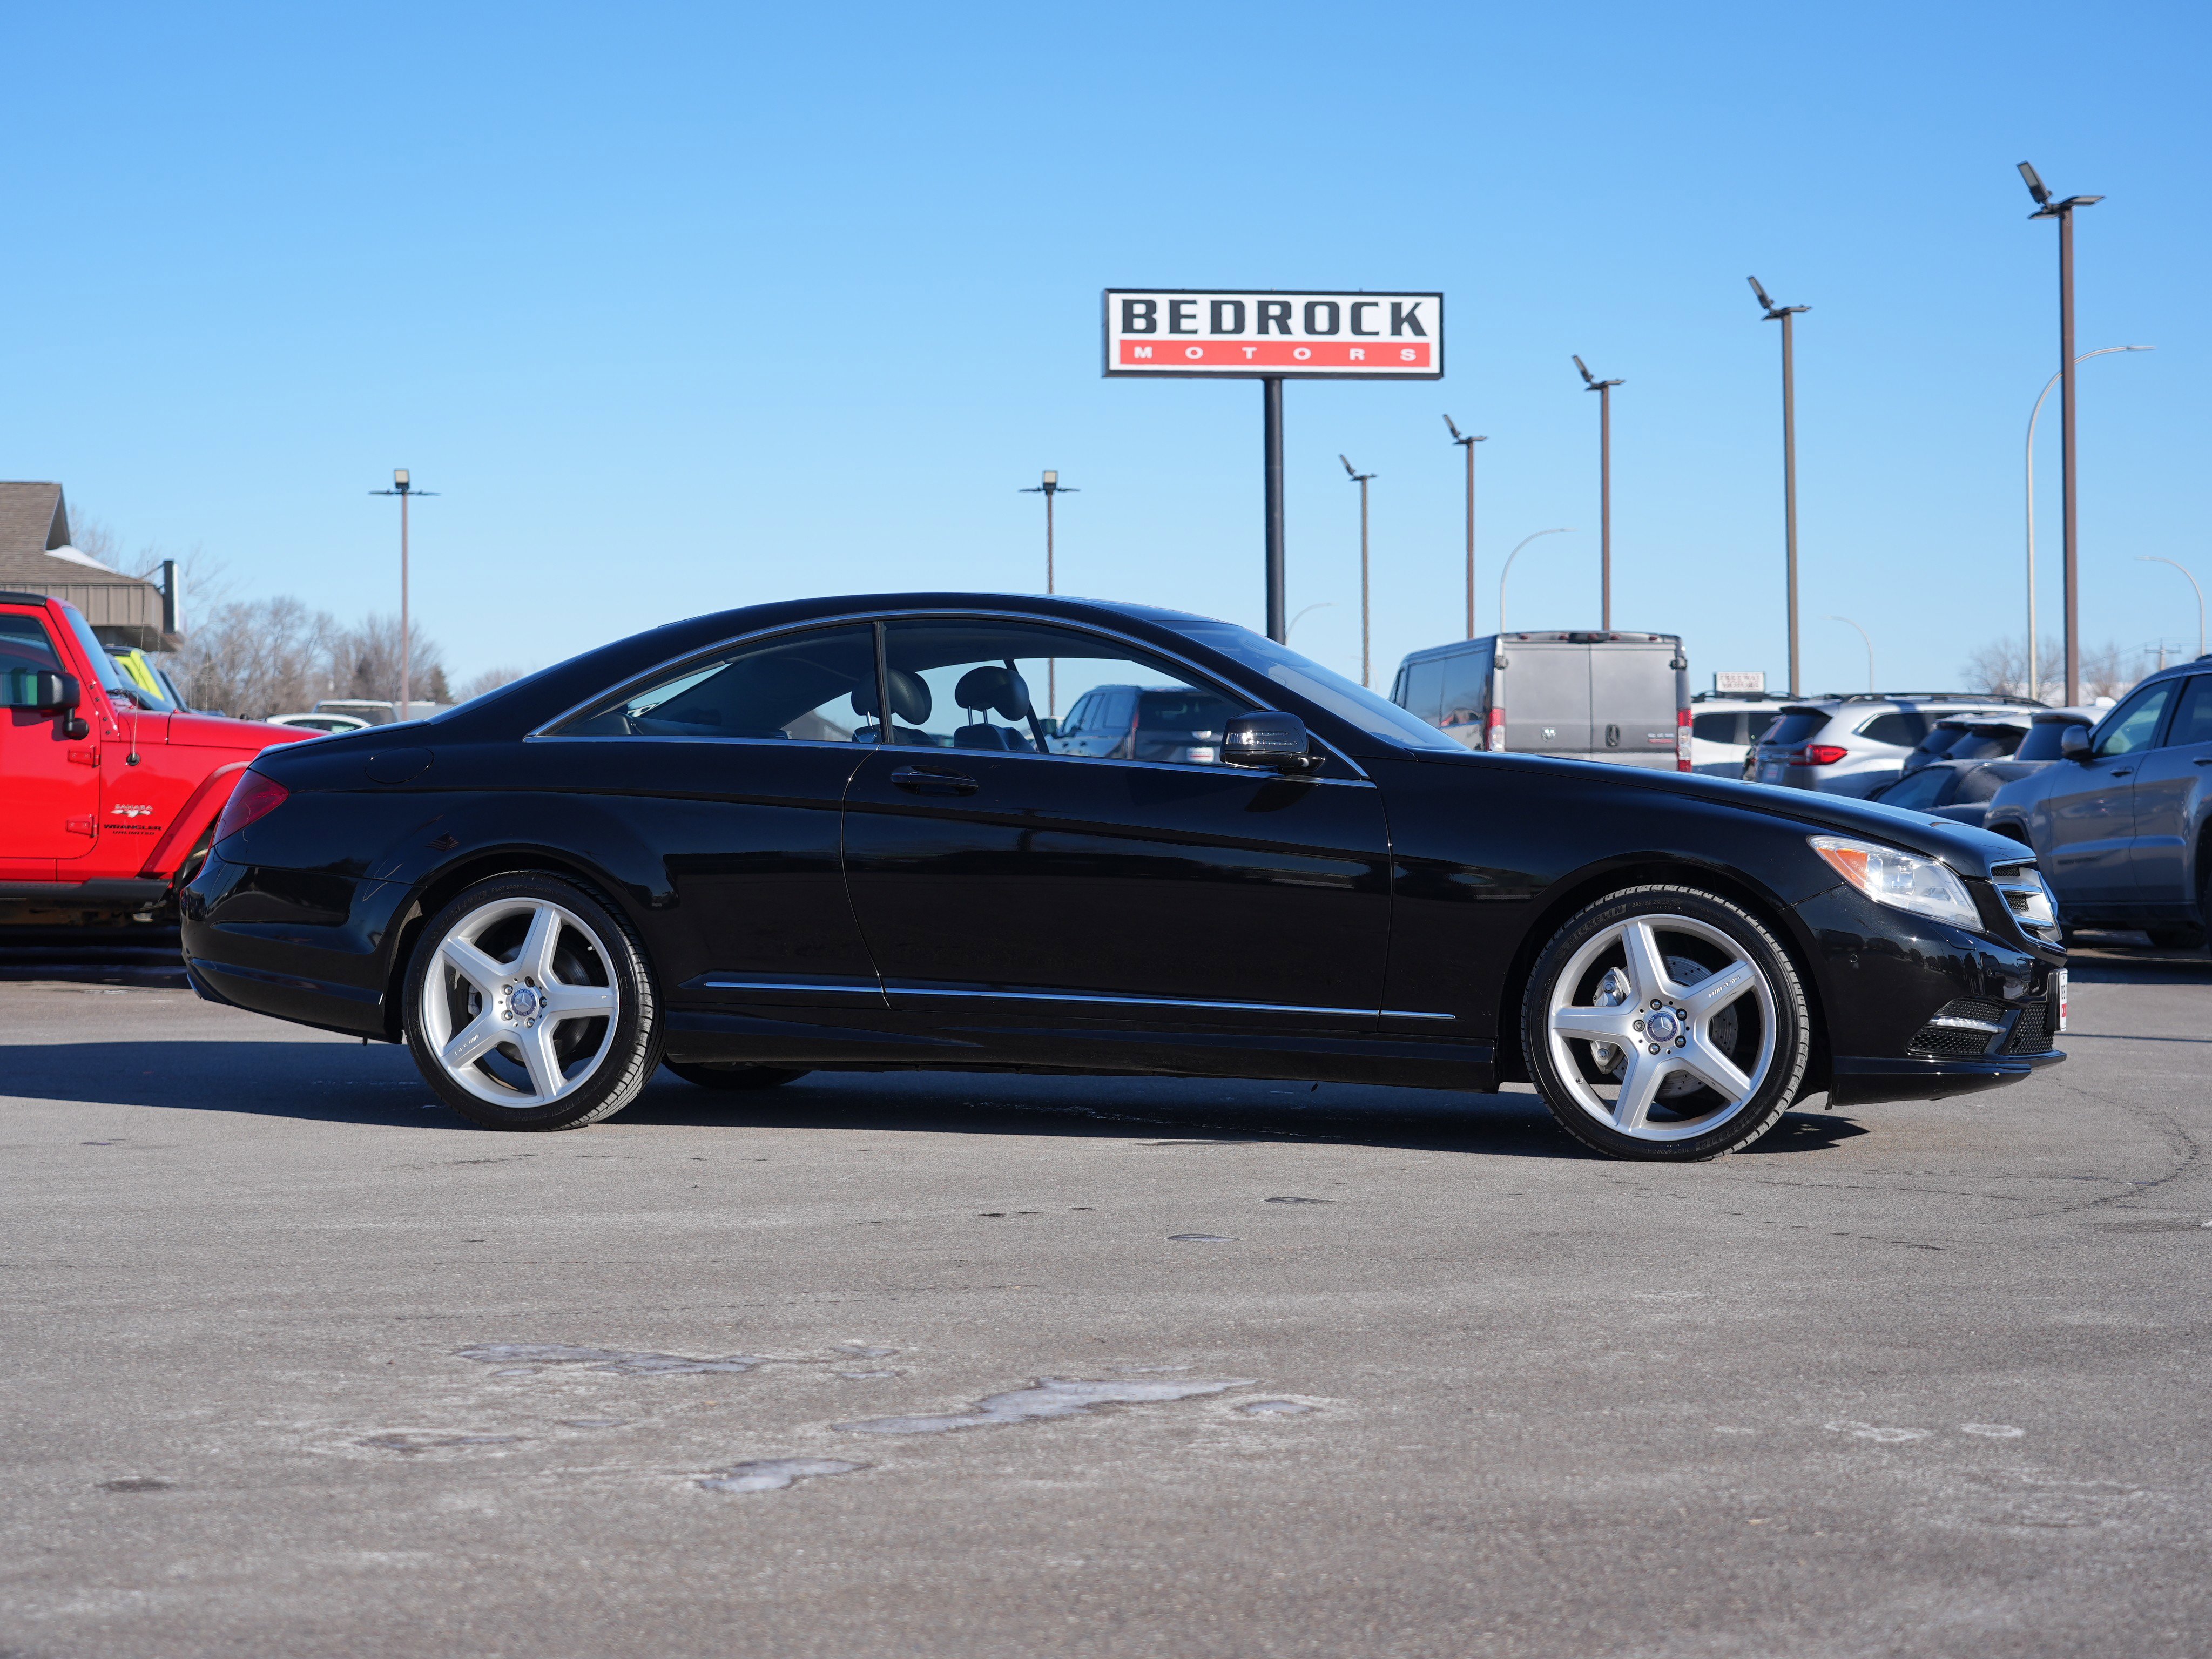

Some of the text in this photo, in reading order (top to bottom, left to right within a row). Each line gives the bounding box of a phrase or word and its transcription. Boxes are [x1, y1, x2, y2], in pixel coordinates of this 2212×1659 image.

[1121, 299, 1428, 336] BEDROCK
[1134, 346, 1417, 361] MOTORS
[1567, 905, 1624, 946] MICHELIN
[1699, 1109, 1756, 1149] MICHELIN
